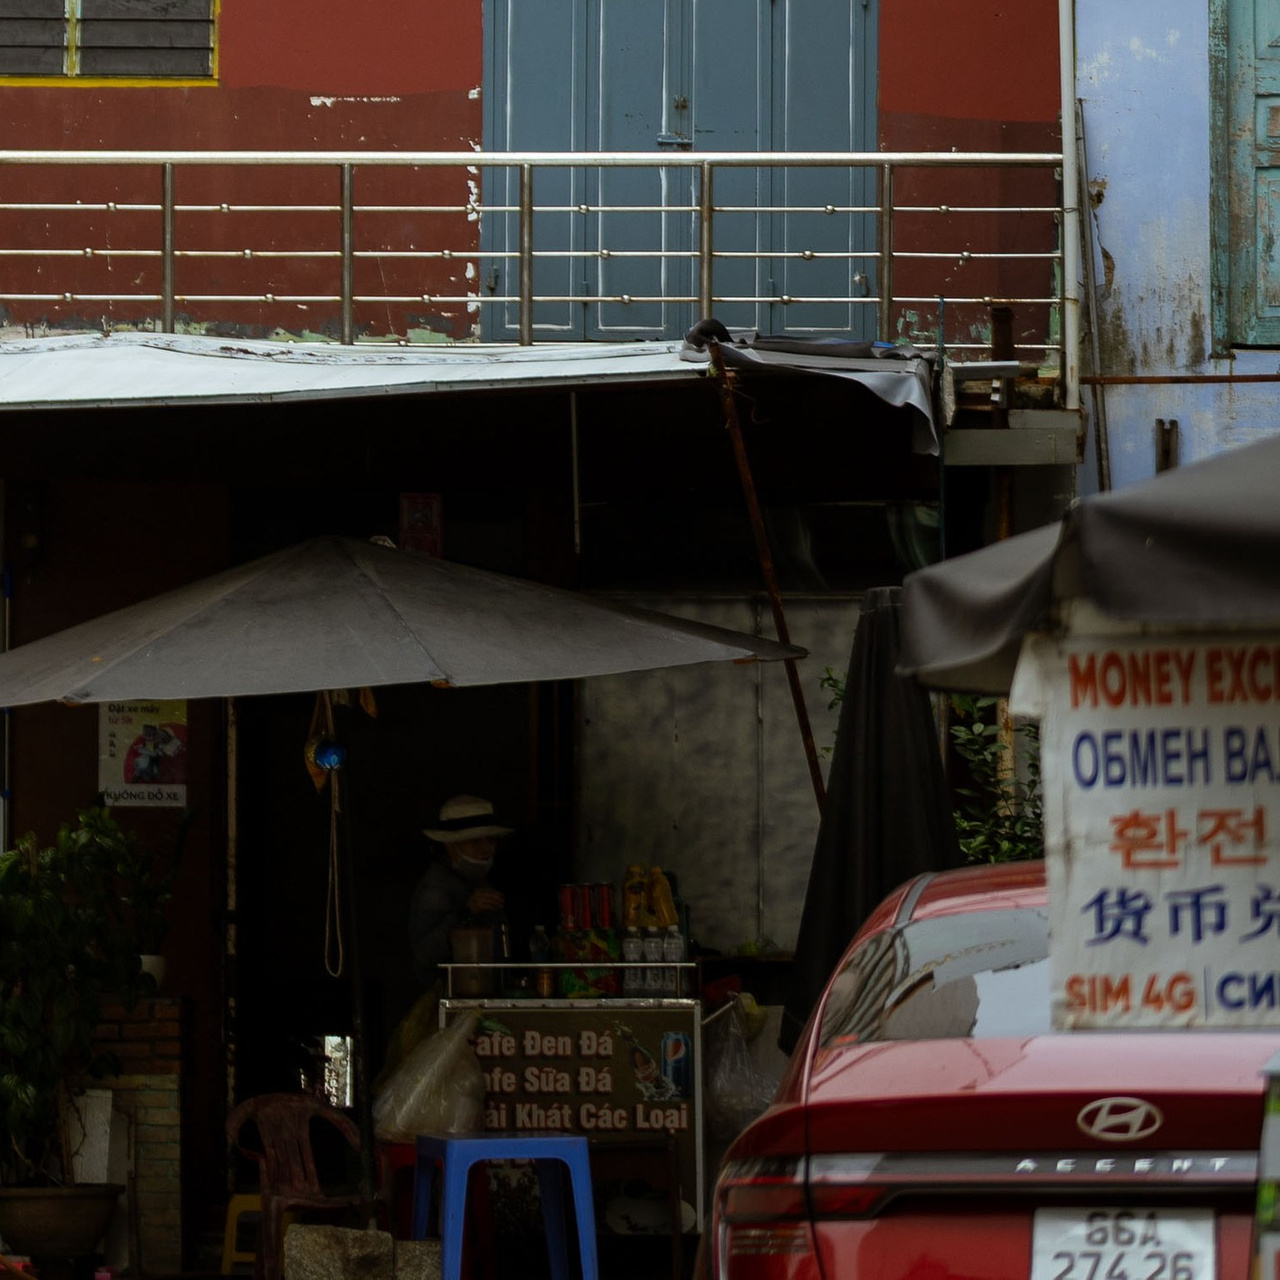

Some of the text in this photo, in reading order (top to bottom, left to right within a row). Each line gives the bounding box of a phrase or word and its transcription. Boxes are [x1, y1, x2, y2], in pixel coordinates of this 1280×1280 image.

[1070, 649, 1195, 710] MONEY
[1072, 725, 1280, 789] ОБМЕН ВА
[166, 791, 180, 800] XE
[1109, 805, 1268, 870] 환전
[1065, 971, 1280, 1014] SIM 4G СИ
[475, 1029, 613, 1057] afe Đen Đá
[524, 1065, 570, 1092] Sữa
[578, 1066, 612, 1092] Đá
[516, 1103, 572, 1128] Khát
[580, 1103, 628, 1128] Các
[636, 1103, 688, 1135] Loại
[1015, 1157, 1230, 1173] ACCENT
